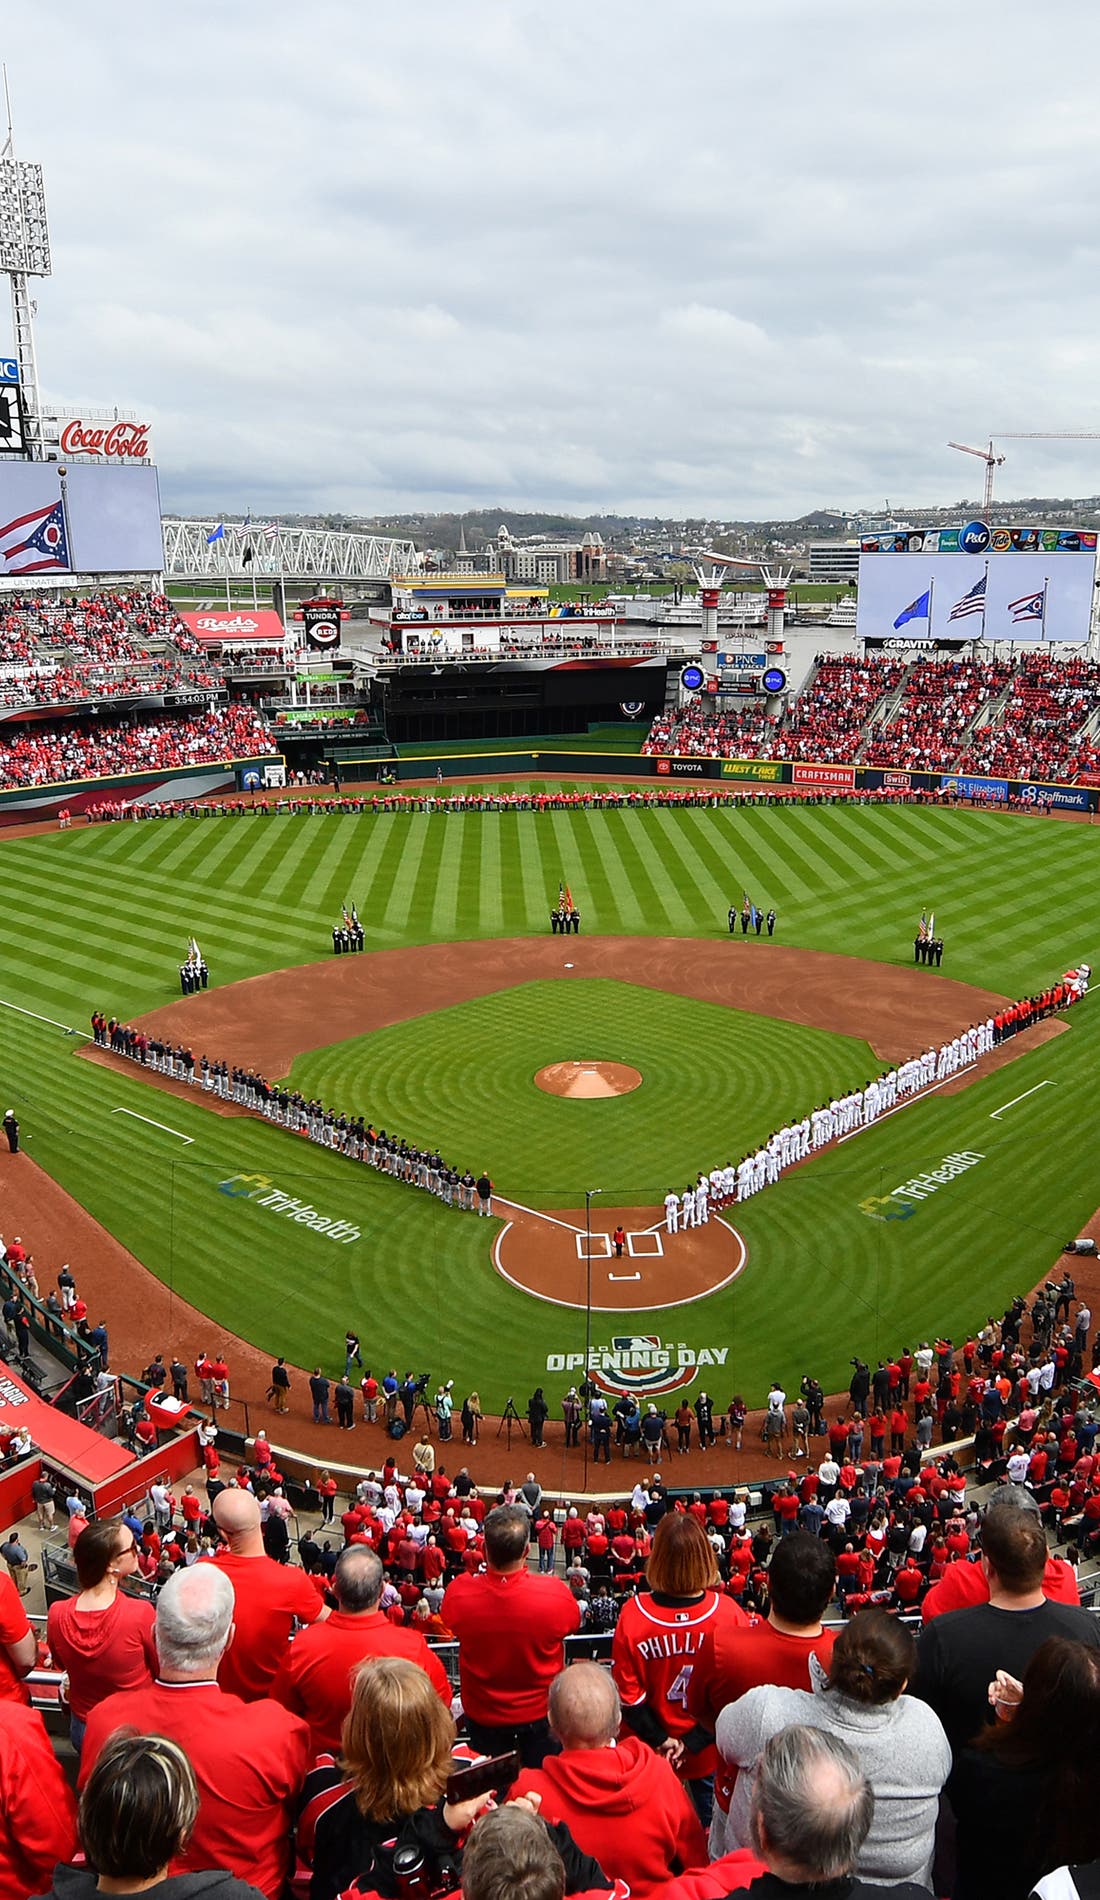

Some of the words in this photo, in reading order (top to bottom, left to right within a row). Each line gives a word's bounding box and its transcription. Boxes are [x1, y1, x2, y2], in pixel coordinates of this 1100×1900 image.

[61, 420, 151, 457] Coca-Cola
[965, 532, 987, 544] P&G
[993, 535, 1009, 548] Tide
[14, 578, 56, 586] ULTIMATE
[305, 612, 338, 620] TUNDRA
[582, 607, 615, 616] TriHealth
[196, 616, 259, 631] Reds
[888, 639, 936, 649] GRAVITY
[735, 654, 758, 665] PNC
[174, 693, 205, 705] 3:54:03
[206, 692, 219, 702] PM
[672, 763, 703, 773] TOYOTA
[723, 764, 751, 774] WEST
[752, 766, 777, 776] LAKE
[796, 769, 852, 782] CRAFTSMAN
[886, 774, 909, 785] Swift
[969, 783, 1005, 794] Elizabeth
[1038, 789, 1085, 805] Staffmark
[891, 1150, 986, 1200] TriHealth
[257, 1188, 361, 1244] TriHealth
[546, 1350, 670, 1371] OPENING
[677, 1347, 729, 1367] DAY
[667, 1664, 694, 1709] 4
